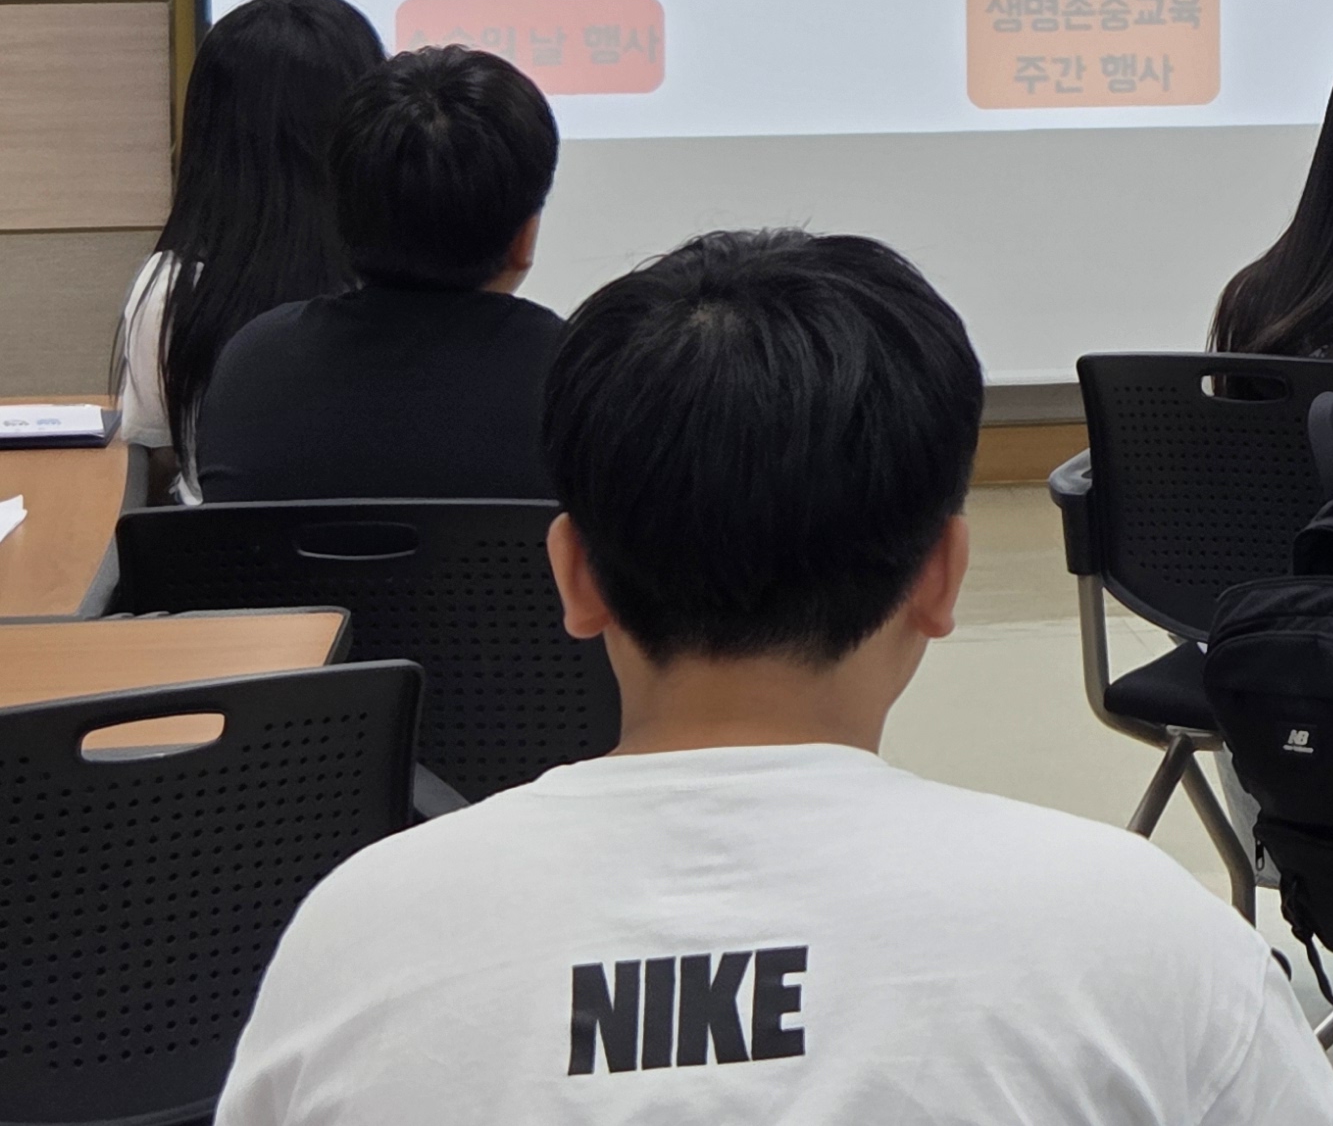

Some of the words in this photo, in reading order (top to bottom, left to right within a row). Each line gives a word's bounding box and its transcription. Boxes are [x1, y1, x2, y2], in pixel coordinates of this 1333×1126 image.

[528, 24, 568, 67] 날
[583, 23, 662, 66] 행사
[1013, 54, 1087, 95] 주간
[1098, 53, 1175, 94] 행사
[567, 944, 809, 1076] NIKE
